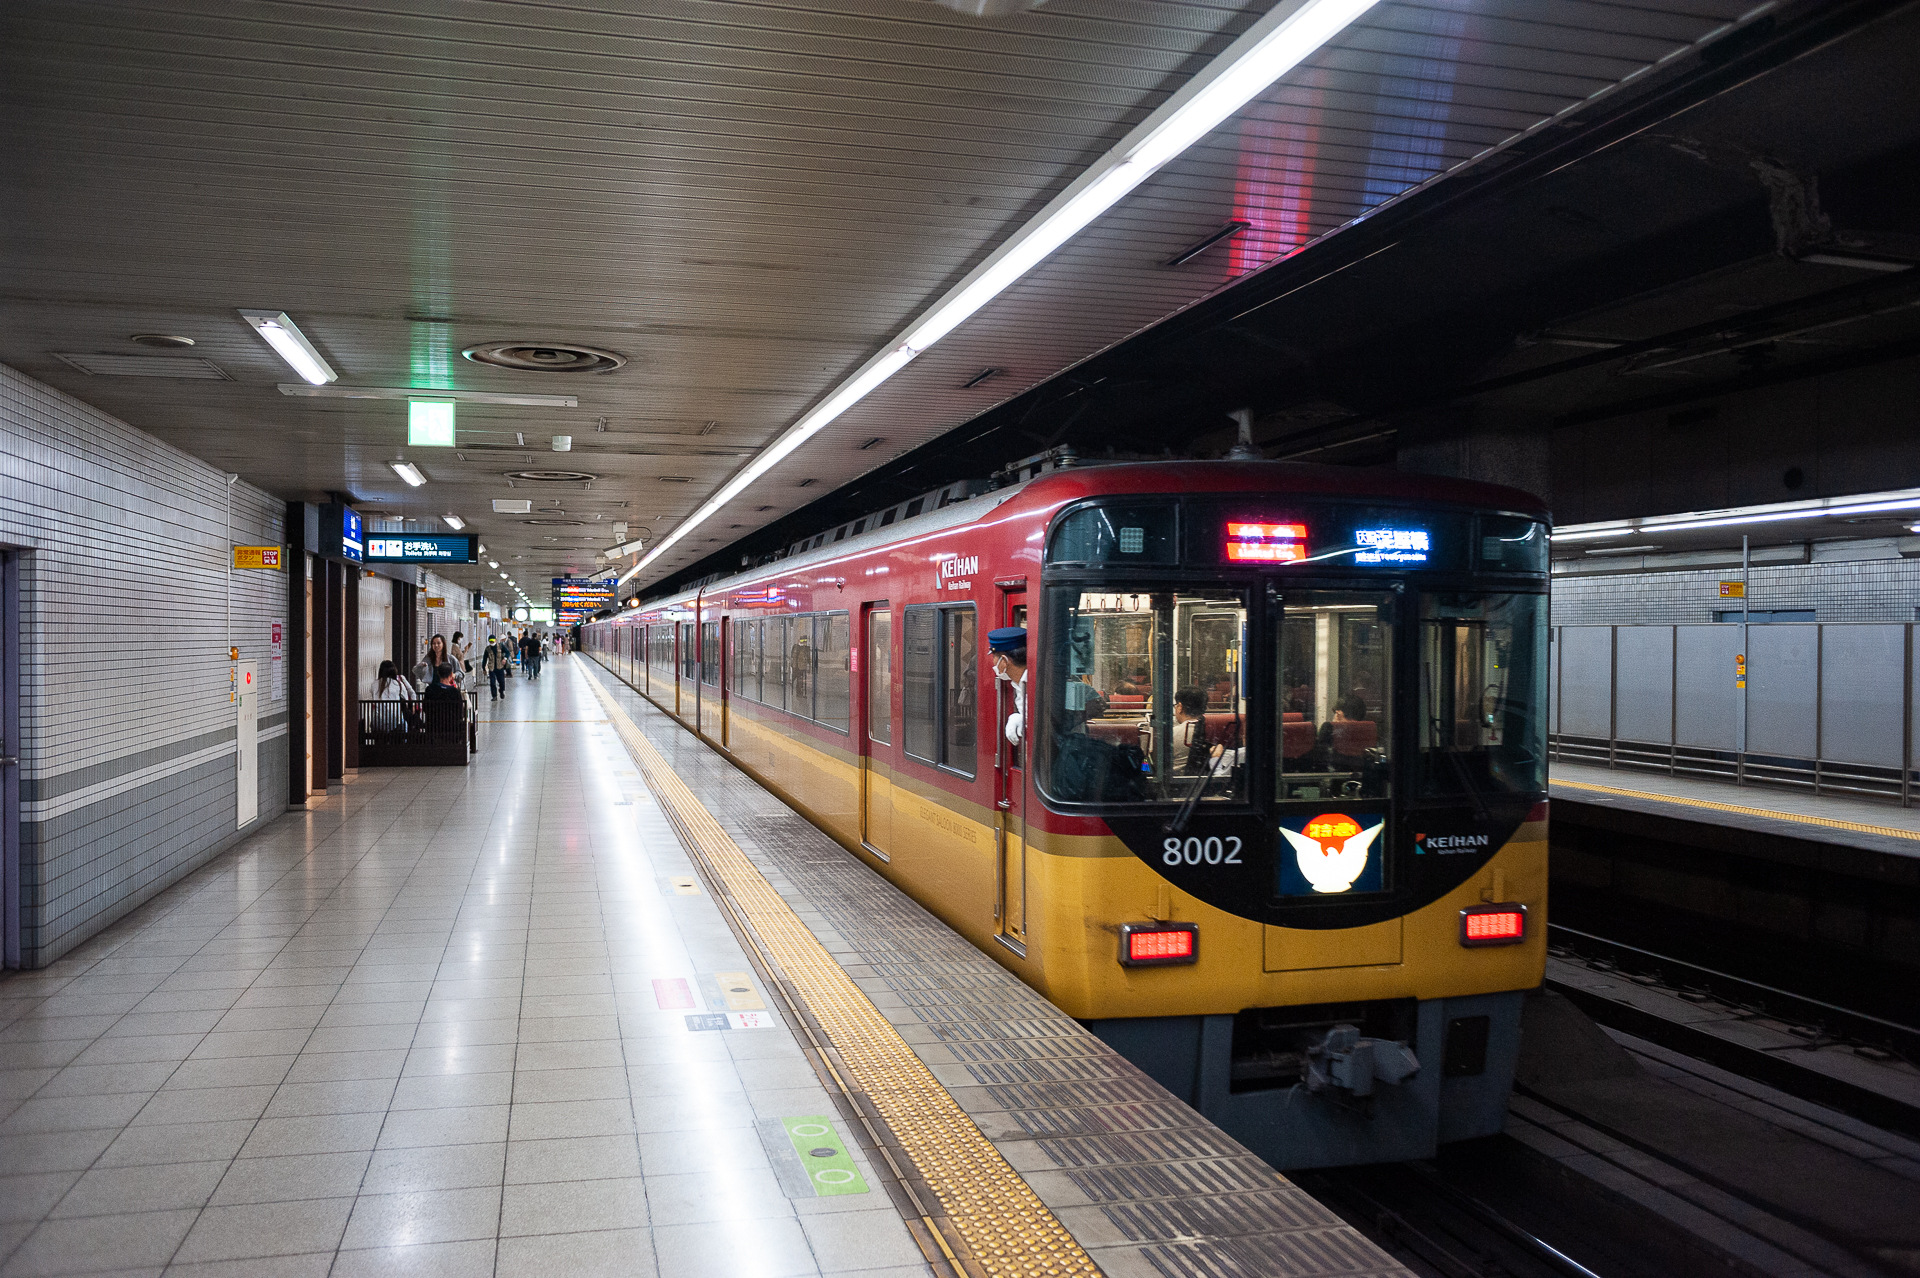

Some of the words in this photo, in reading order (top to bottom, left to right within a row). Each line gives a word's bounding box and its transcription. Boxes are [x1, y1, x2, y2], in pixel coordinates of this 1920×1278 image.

[404, 541, 437, 551] お手洗い
[942, 556, 978, 578] KEIHAN
[1310, 823, 1356, 837] 特急
[1427, 834, 1488, 848] KEIHAN
[1163, 835, 1243, 866] 8002
